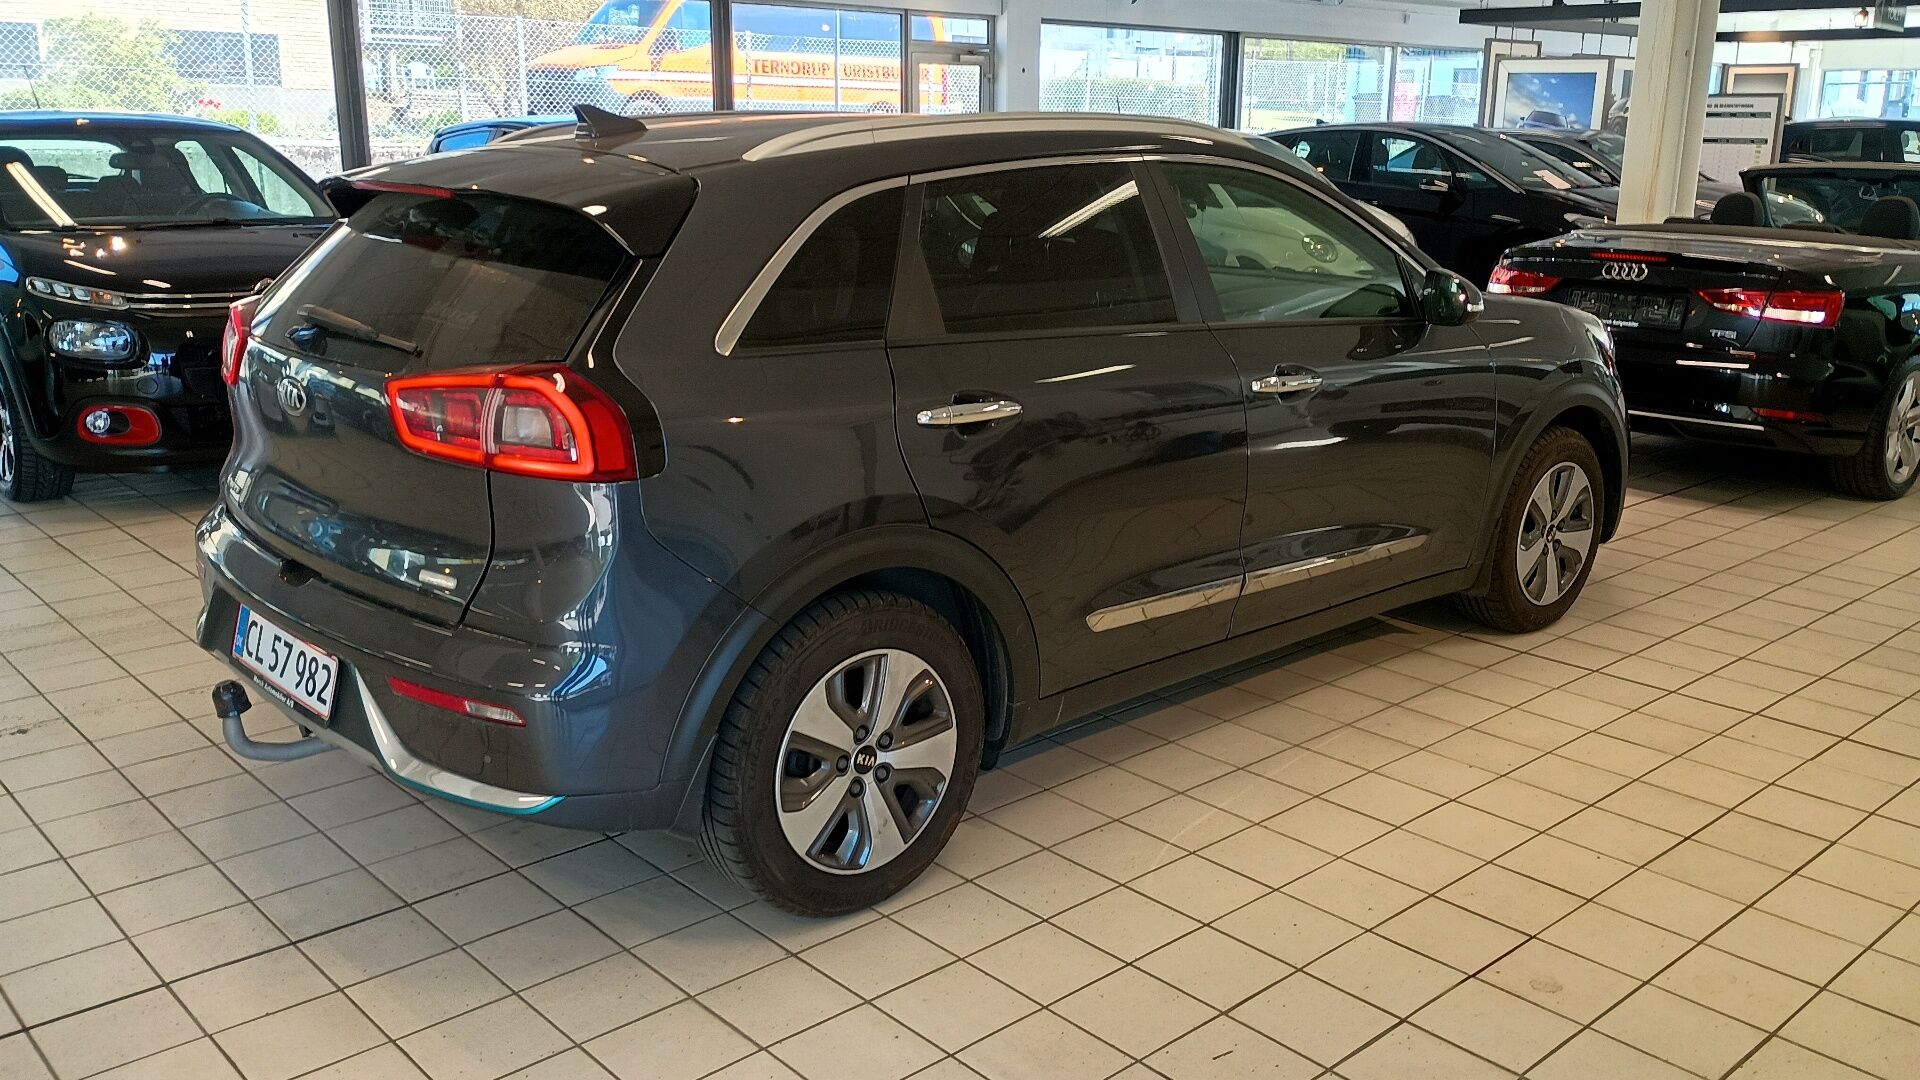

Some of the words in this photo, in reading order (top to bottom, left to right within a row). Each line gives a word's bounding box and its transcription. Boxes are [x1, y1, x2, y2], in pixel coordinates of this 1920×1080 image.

[245, 619, 264, 665] CL
[268, 633, 293, 678] 57
[295, 650, 331, 705] 982
[856, 753, 875, 767] KIA
